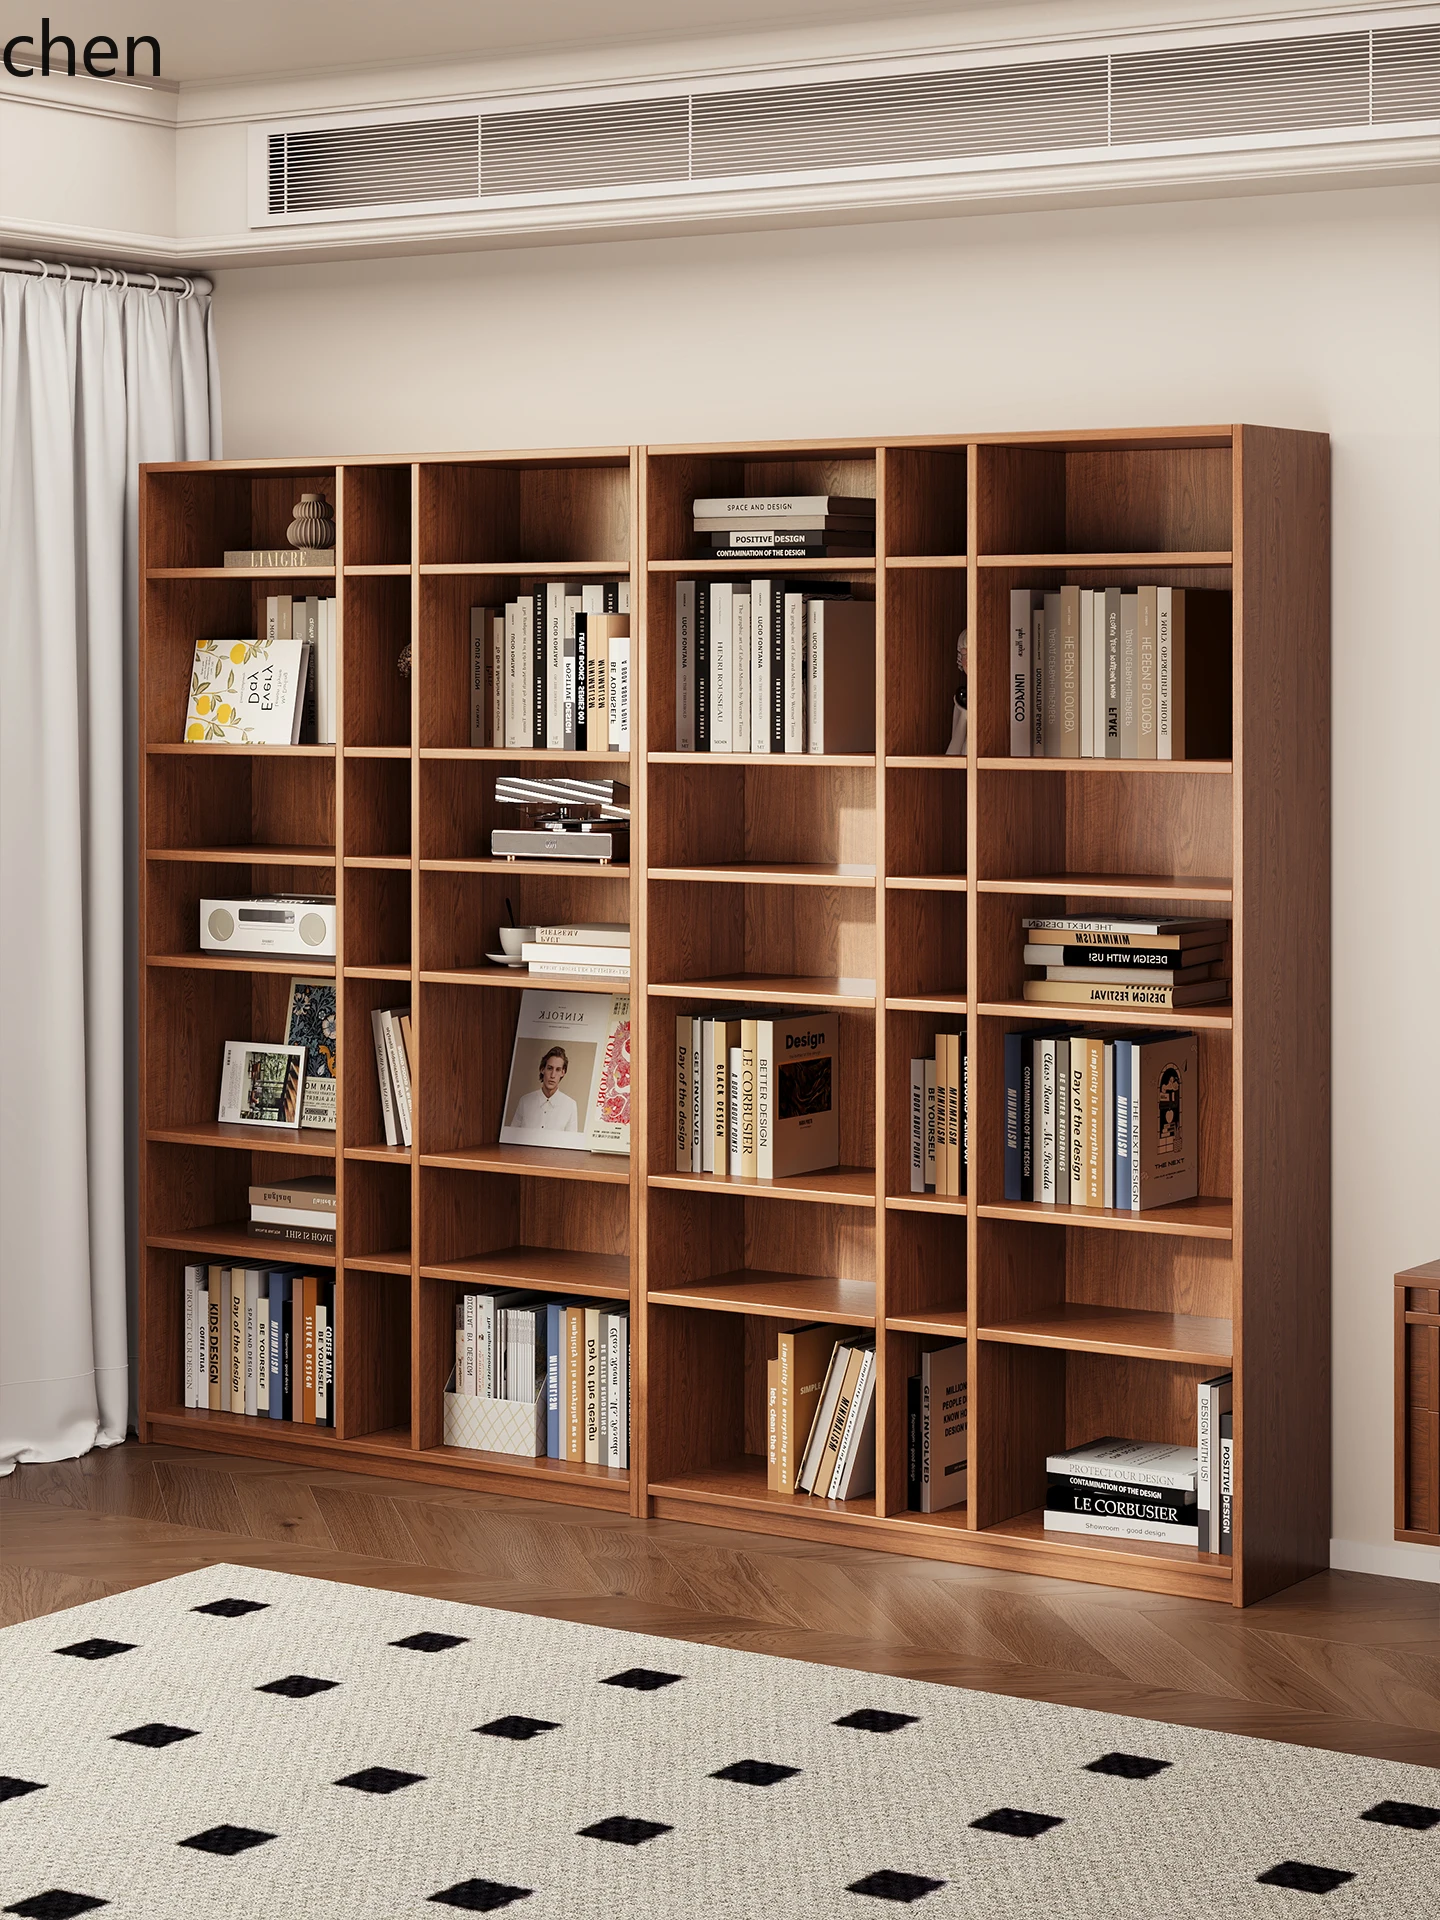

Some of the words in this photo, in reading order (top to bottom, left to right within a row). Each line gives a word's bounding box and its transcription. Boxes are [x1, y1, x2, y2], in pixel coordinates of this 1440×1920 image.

[774, 535, 805, 543] DESIGN
[251, 551, 307, 568] LIAIGRE
[786, 1032, 825, 1050] Design
[678, 1046, 686, 1070] Day
[742, 1049, 753, 1066] LE
[1044, 1053, 1053, 1080] Class
[678, 1074, 687, 1086] of
[760, 1059, 768, 1100] BETTER
[1072, 1070, 1082, 1095] Day
[1090, 1049, 1098, 1094] simplicity
[678, 1088, 687, 1108] the
[928, 1088, 935, 1102] BE
[1044, 1084, 1053, 1115] Room
[1074, 1100, 1082, 1113] of
[742, 1070, 753, 1154] CORBUSIER
[937, 1086, 946, 1145] MINIMALISM
[949, 1086, 958, 1146] MINIMALISM
[1074, 1114, 1082, 1136] the
[678, 1110, 686, 1150] design
[760, 1104, 768, 1147] DESIGN
[1118, 1096, 1128, 1158] MINIMALISM
[1090, 1118, 1098, 1166] everything
[1044, 1150, 1053, 1190] Posada
[1072, 1138, 1082, 1182] design
[1092, 1168, 1097, 1180] we
[210, 1303, 218, 1333] KIDS
[234, 1320, 240, 1334] of
[260, 1323, 265, 1336] BE
[210, 1336, 218, 1384] DESIGN
[780, 1342, 789, 1386] simplicity
[232, 1356, 240, 1392] design
[800, 1382, 821, 1395] SIMPLE
[780, 1408, 788, 1454] everything
[828, 1396, 850, 1452] MINIMALISM
[782, 1456, 788, 1468] we
[1069, 1464, 1113, 1476] PROTECT
[1114, 1470, 1136, 1481] OUR
[1138, 1474, 1175, 1486] DESIGN
[1070, 1477, 1118, 1492] CONTAMINATION
[1128, 1487, 1139, 1495] THE
[1140, 1489, 1162, 1500] DESIGN
[1074, 1496, 1092, 1512] LE
[1094, 1500, 1178, 1522] CORBUSIER
